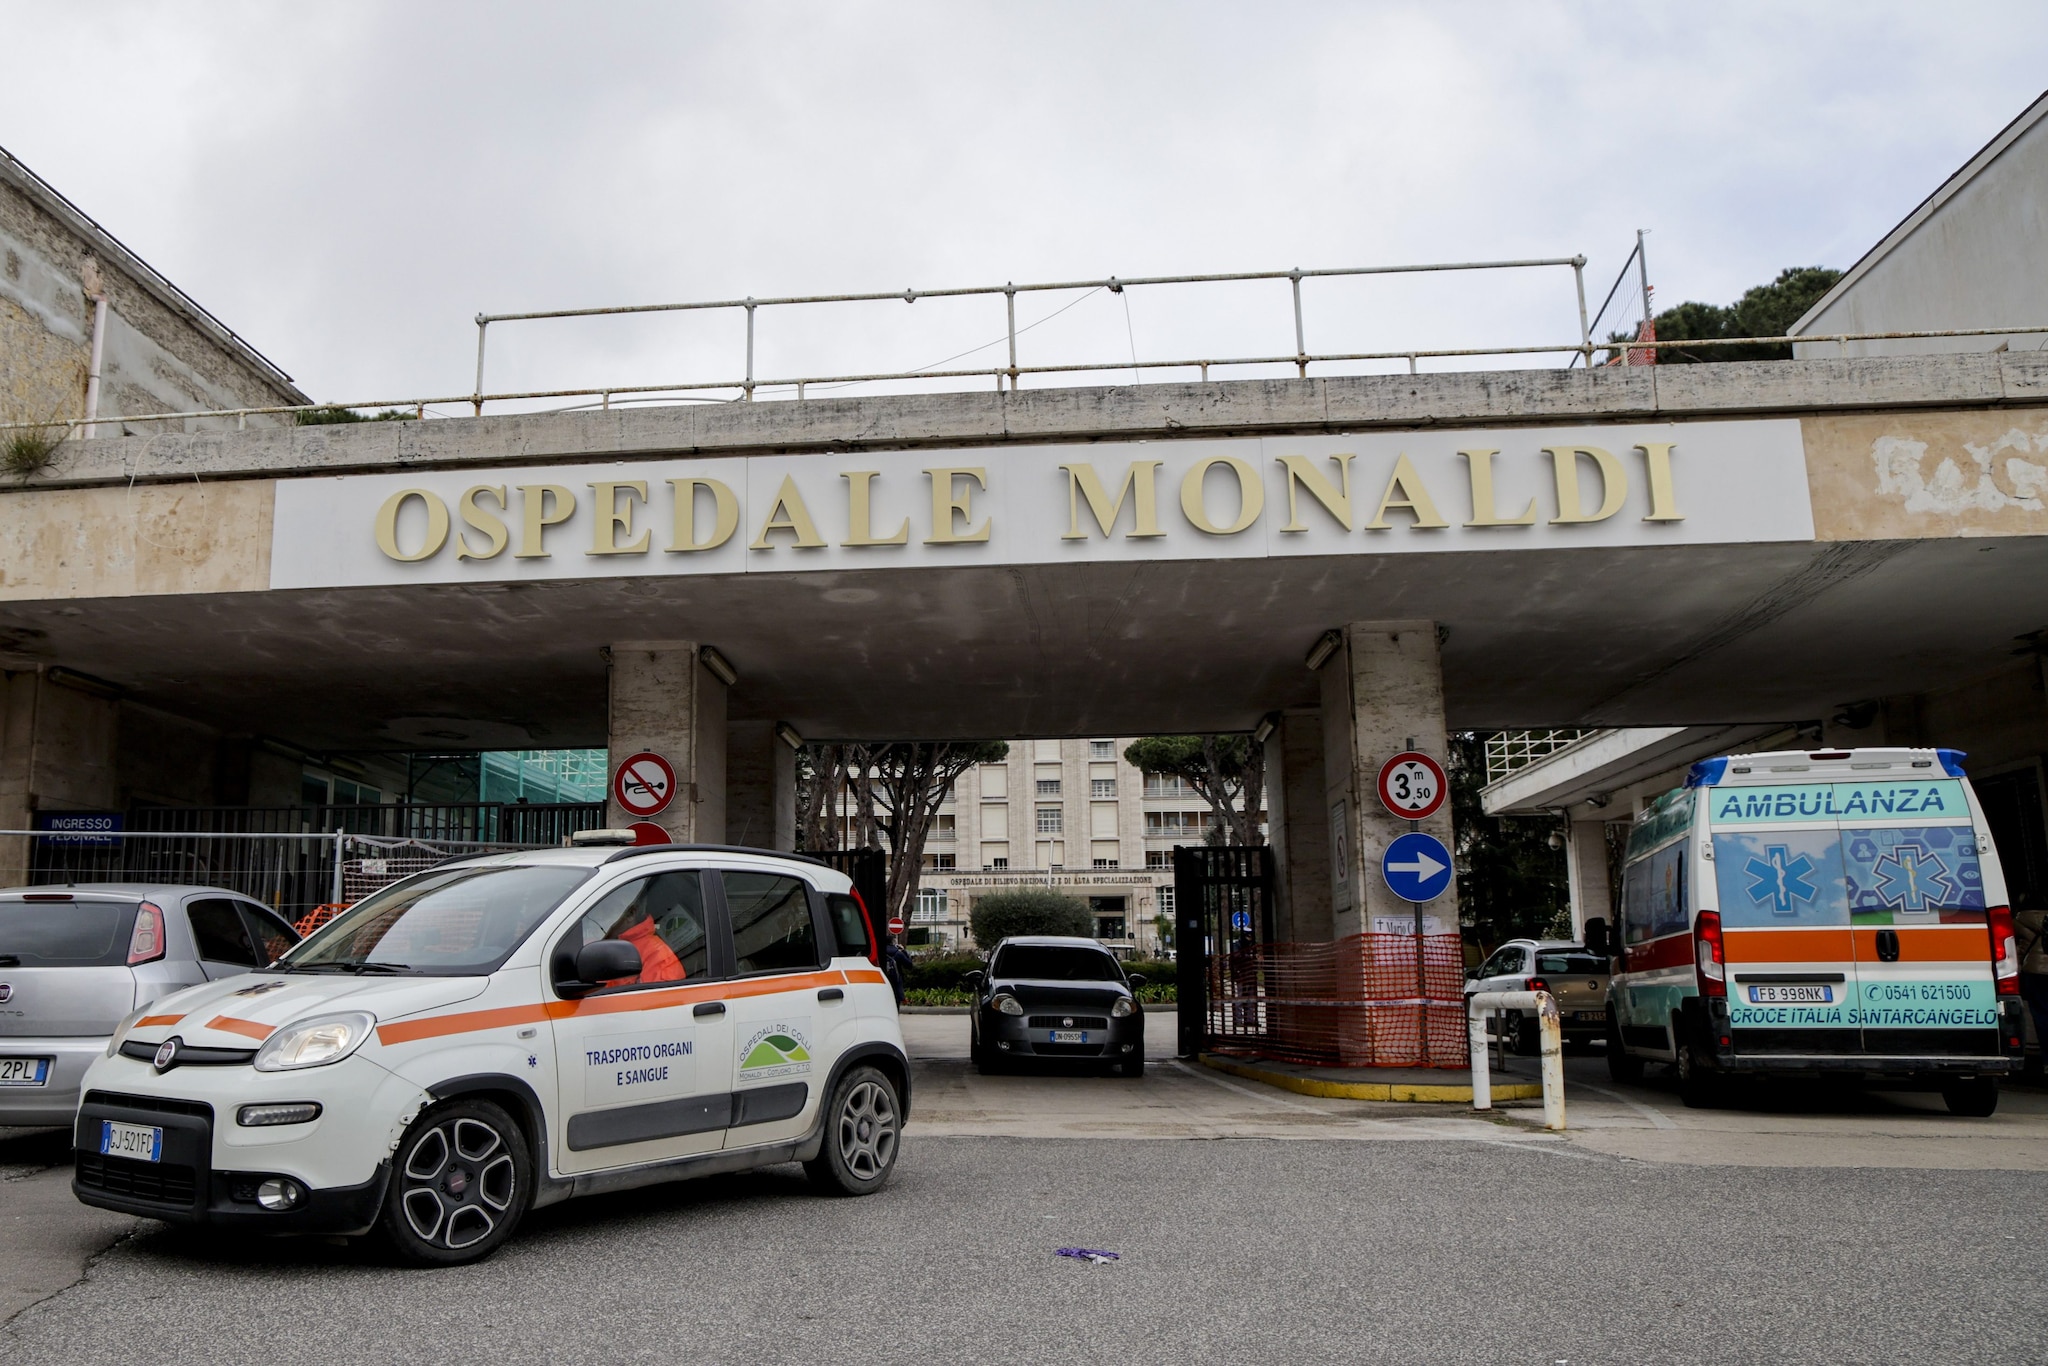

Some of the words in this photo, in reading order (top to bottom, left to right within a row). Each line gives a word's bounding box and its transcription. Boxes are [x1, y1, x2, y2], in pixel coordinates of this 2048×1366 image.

[374, 466, 992, 562] OSPEDALE
[1058, 442, 1686, 540] MONALDI
[1394, 773, 1411, 800] 3
[1719, 787, 1945, 819] AMBULANZA
[51, 818, 112, 830] INGRESSO
[951, 878, 983, 886] OSPEDALE
[1020, 877, 1056, 885] NAZIONAE
[1074, 877, 1090, 885] ALTA
[1092, 876, 1153, 884] SPECIALIZZAZIONE
[1759, 987, 1776, 1001] FB
[1780, 987, 1823, 1001] 998NK
[1885, 985, 1917, 1000] 0541
[1921, 985, 1971, 1000] 621500
[1730, 1008, 1788, 1024] CROCE
[1791, 1007, 1842, 1024] ITALIA
[1847, 1008, 1997, 1025] SANTARCANGELO
[739, 1024, 773, 1062] OSPEDALI
[776, 1024, 789, 1033] DEI
[791, 1028, 812, 1051] COLLI
[586, 1045, 652, 1066] TRASPORTO
[653, 1041, 693, 1058] ORGANI
[616, 1072, 623, 1086] E
[625, 1066, 669, 1084] SANGUE
